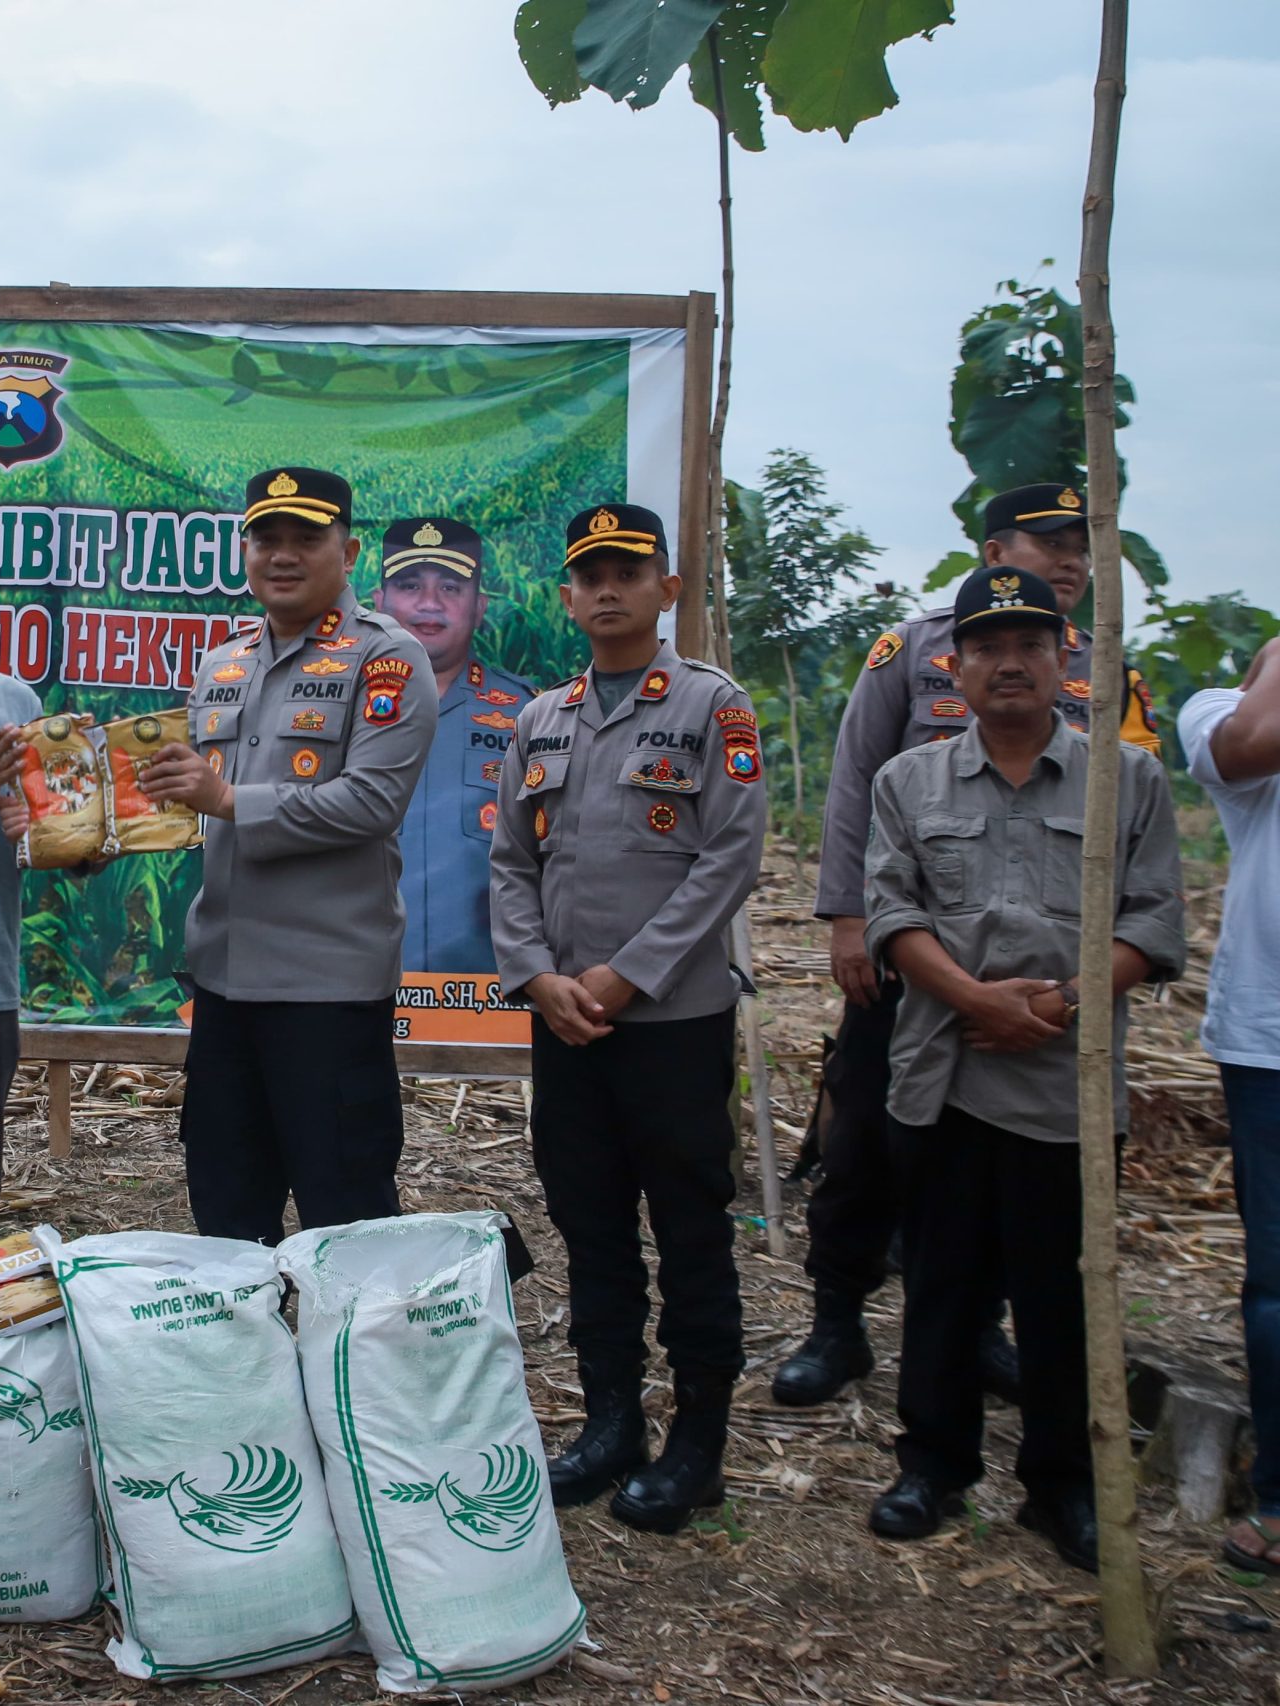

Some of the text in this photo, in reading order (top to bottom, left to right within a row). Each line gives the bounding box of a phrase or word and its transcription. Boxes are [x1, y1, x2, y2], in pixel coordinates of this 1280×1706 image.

[12, 355, 54, 368] TIMUR
[126, 516, 249, 590] JAGU
[203, 686, 242, 704] ARDI
[291, 682, 345, 700] POLRI
[636, 730, 704, 754] POLRI
[443, 982, 484, 1012] S.H.,
[130, 1296, 184, 1321] BUANA
[183, 1290, 226, 1312] LANG
[438, 1298, 470, 1319] LANG
[162, 1318, 184, 1332] Oleh
[0, 1571, 22, 1583] Oleh
[0, 1579, 50, 1601] BUANA
